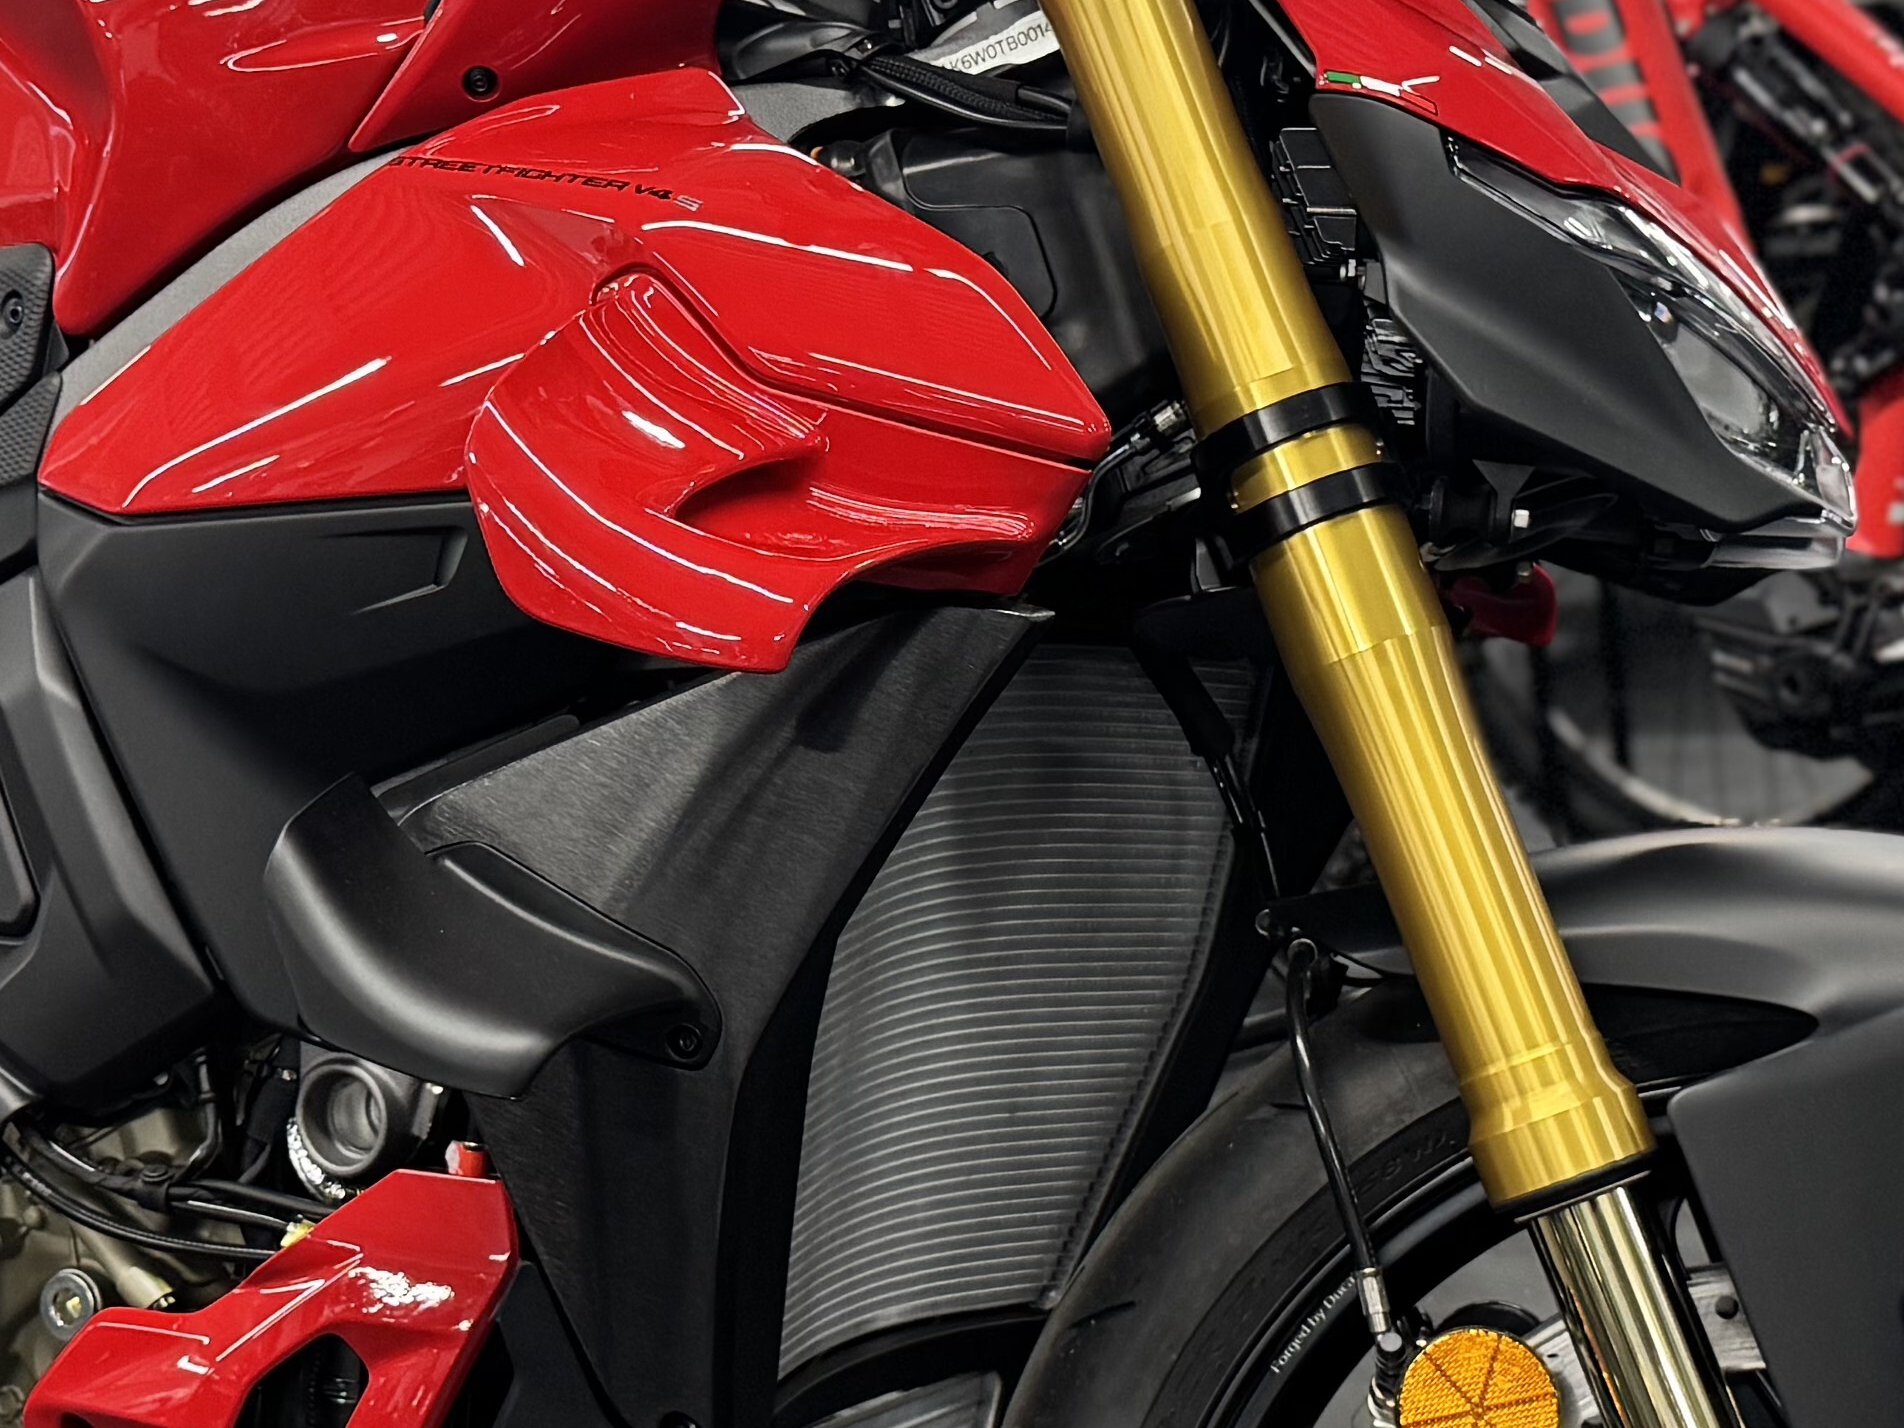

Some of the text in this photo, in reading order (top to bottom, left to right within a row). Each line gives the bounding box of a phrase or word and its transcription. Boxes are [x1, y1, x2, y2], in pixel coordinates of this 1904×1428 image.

[390, 155, 703, 212] STREETFIGHTER V4 S
[1269, 1271, 1358, 1374] Forged by Duca
